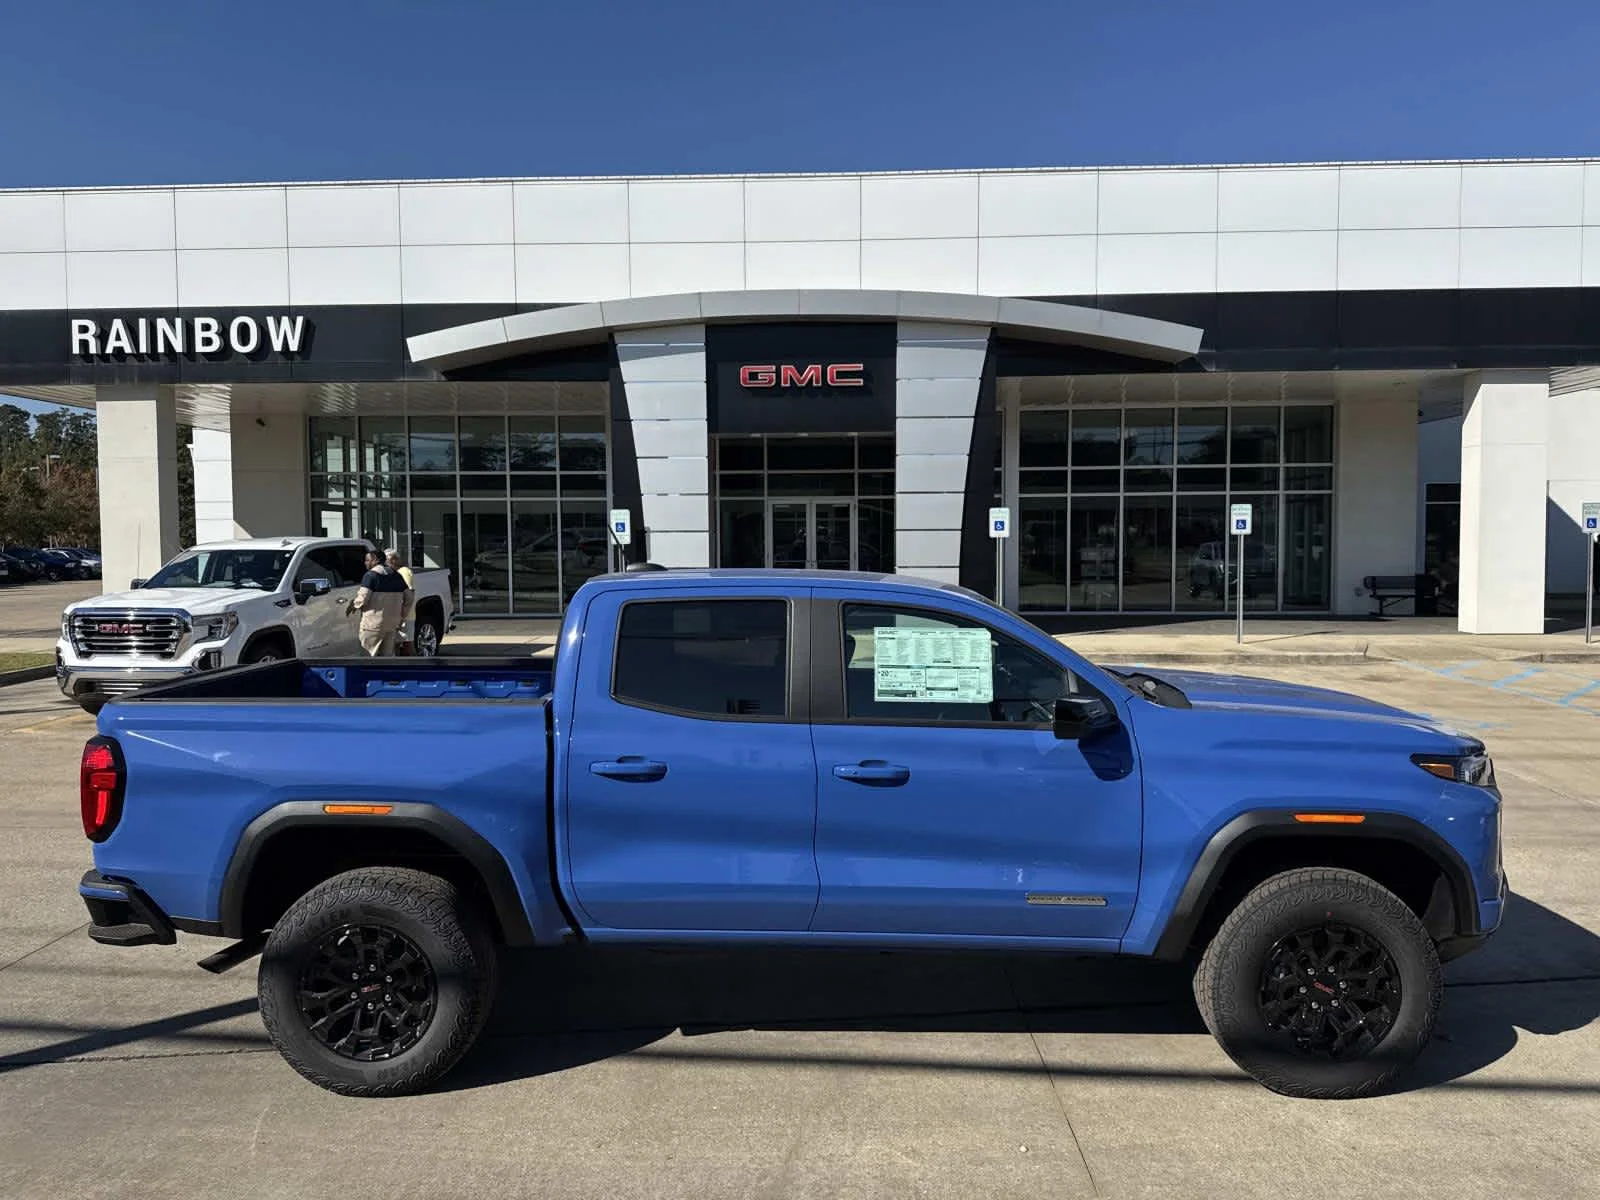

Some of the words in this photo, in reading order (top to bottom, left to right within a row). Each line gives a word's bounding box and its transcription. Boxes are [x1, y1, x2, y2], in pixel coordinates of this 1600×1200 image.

[71, 315, 305, 355] RAINBOW
[740, 363, 864, 387] GMC
[99, 623, 144, 634] GMC
